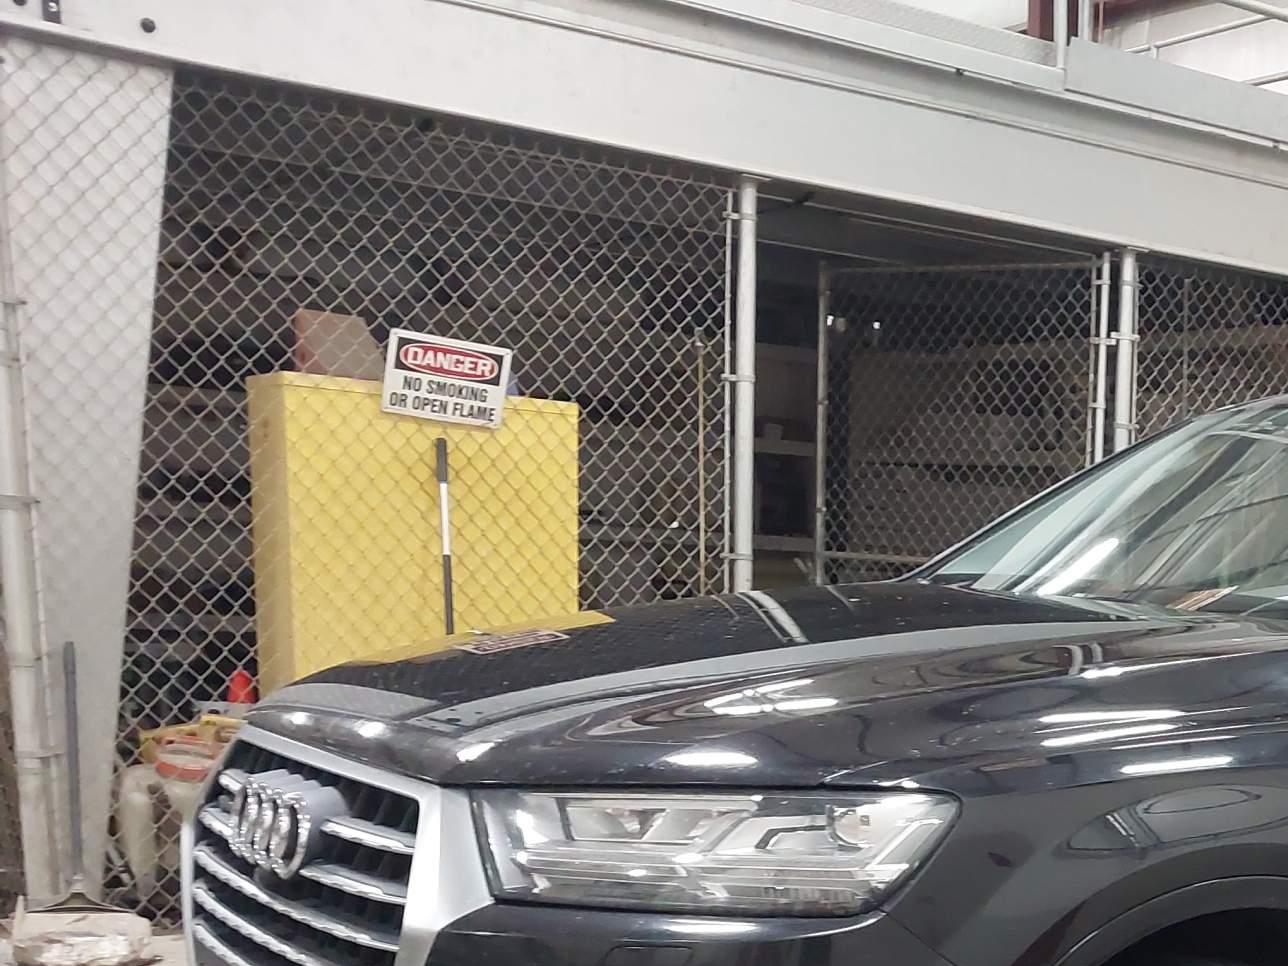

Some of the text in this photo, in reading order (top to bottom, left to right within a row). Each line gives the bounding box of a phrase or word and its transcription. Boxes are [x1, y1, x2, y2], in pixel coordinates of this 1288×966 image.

[407, 347, 492, 377] DANGER
[402, 375, 488, 403] NO SMOKING
[389, 392, 496, 422] OR OPEN FLAME
